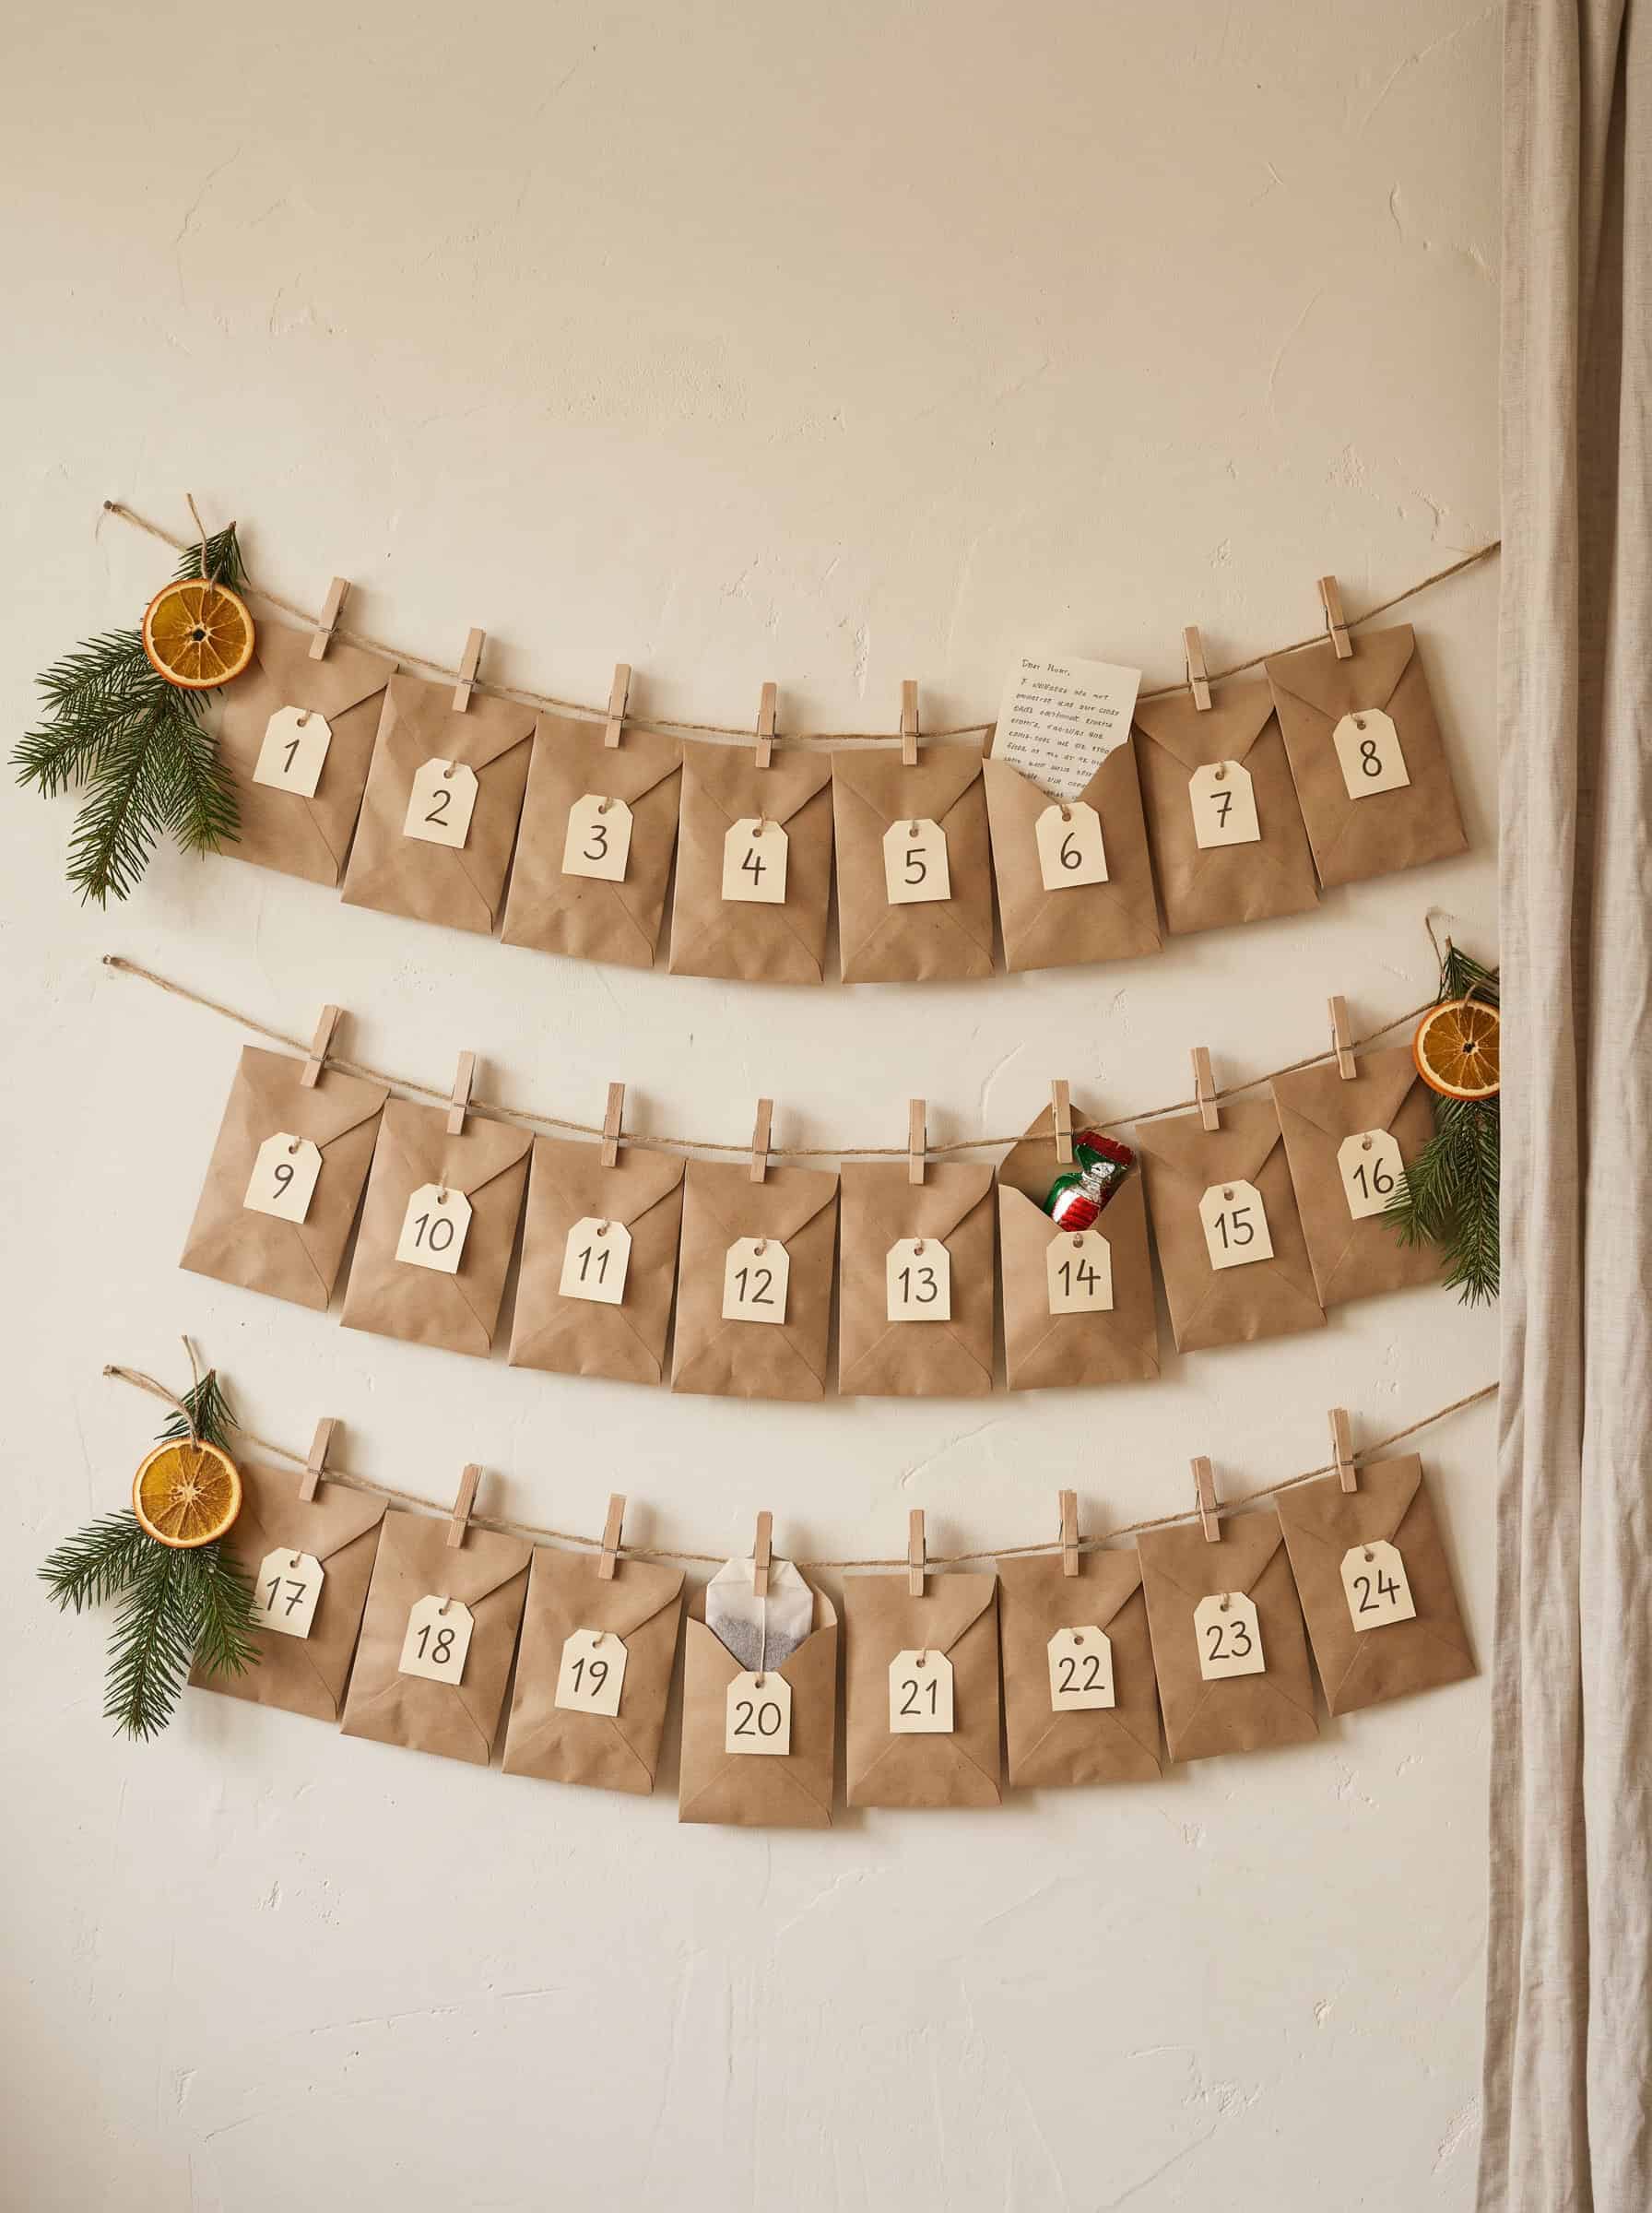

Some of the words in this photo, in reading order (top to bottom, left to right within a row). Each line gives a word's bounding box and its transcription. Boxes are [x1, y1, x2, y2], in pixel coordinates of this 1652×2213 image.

[283, 739, 301, 774] 1
[1359, 739, 1383, 778] 8
[424, 789, 452, 827] 2
[1210, 790, 1233, 829] 7
[583, 824, 608, 861] 3
[1060, 832, 1082, 870] 6
[740, 847, 767, 886] 4
[904, 847, 926, 885] 5
[272, 1164, 294, 1200] 9
[1352, 1157, 1395, 1200] 16
[415, 1213, 454, 1251] 10
[1213, 1206, 1255, 1249] 15
[578, 1246, 610, 1284] 11
[1057, 1258, 1102, 1297] 14
[735, 1267, 775, 1305] 12
[898, 1266, 938, 1304] 13
[266, 1576, 307, 1616] 17
[1352, 1568, 1401, 1614] 24
[418, 1624, 455, 1664] 18
[1206, 1620, 1253, 1662] 23
[571, 1657, 608, 1698] 19
[1058, 1654, 1105, 1694] 22
[899, 1678, 938, 1716] 21
[733, 1700, 782, 1736] 20
